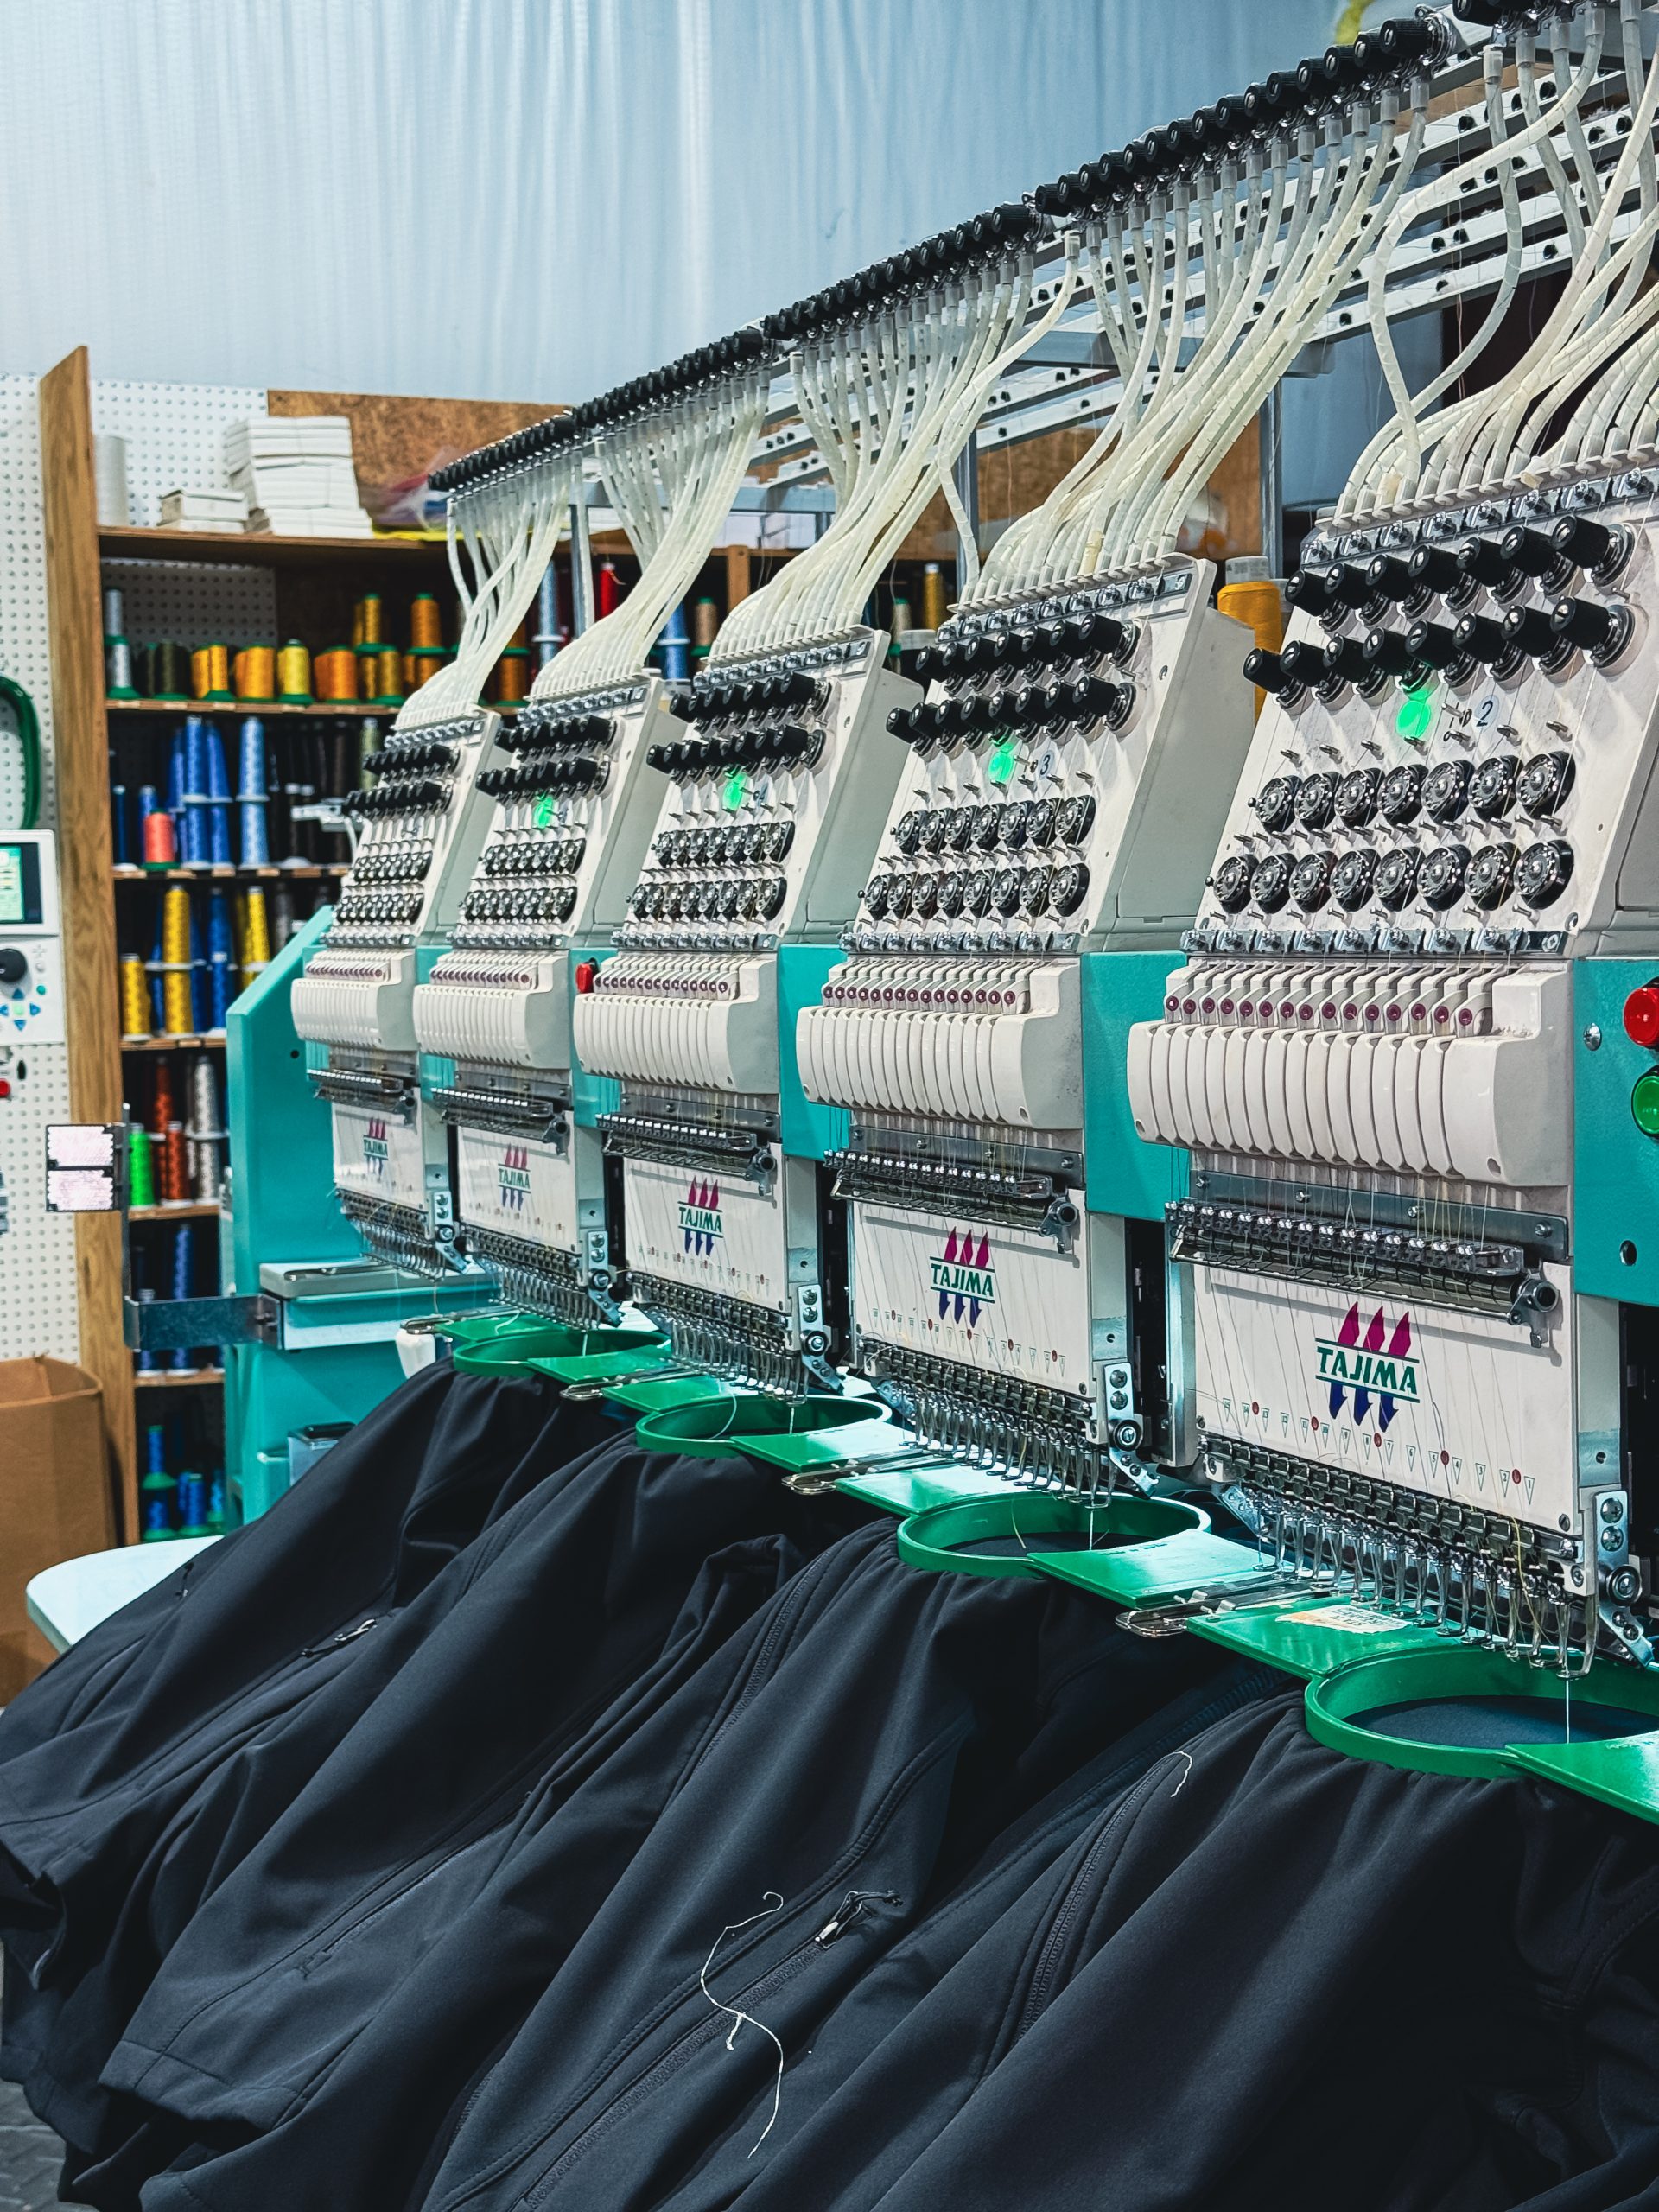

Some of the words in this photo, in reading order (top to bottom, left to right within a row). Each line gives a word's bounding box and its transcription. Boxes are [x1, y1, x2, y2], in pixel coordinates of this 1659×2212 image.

[1476, 700, 1493, 727] 2
[1039, 754, 1051, 775] 3
[498, 1167, 531, 1190] TAJIMA
[679, 1207, 722, 1233] TAJIMA
[931, 1262, 994, 1297] TAJIMA
[1316, 1345, 1418, 1395] TAJIMA
